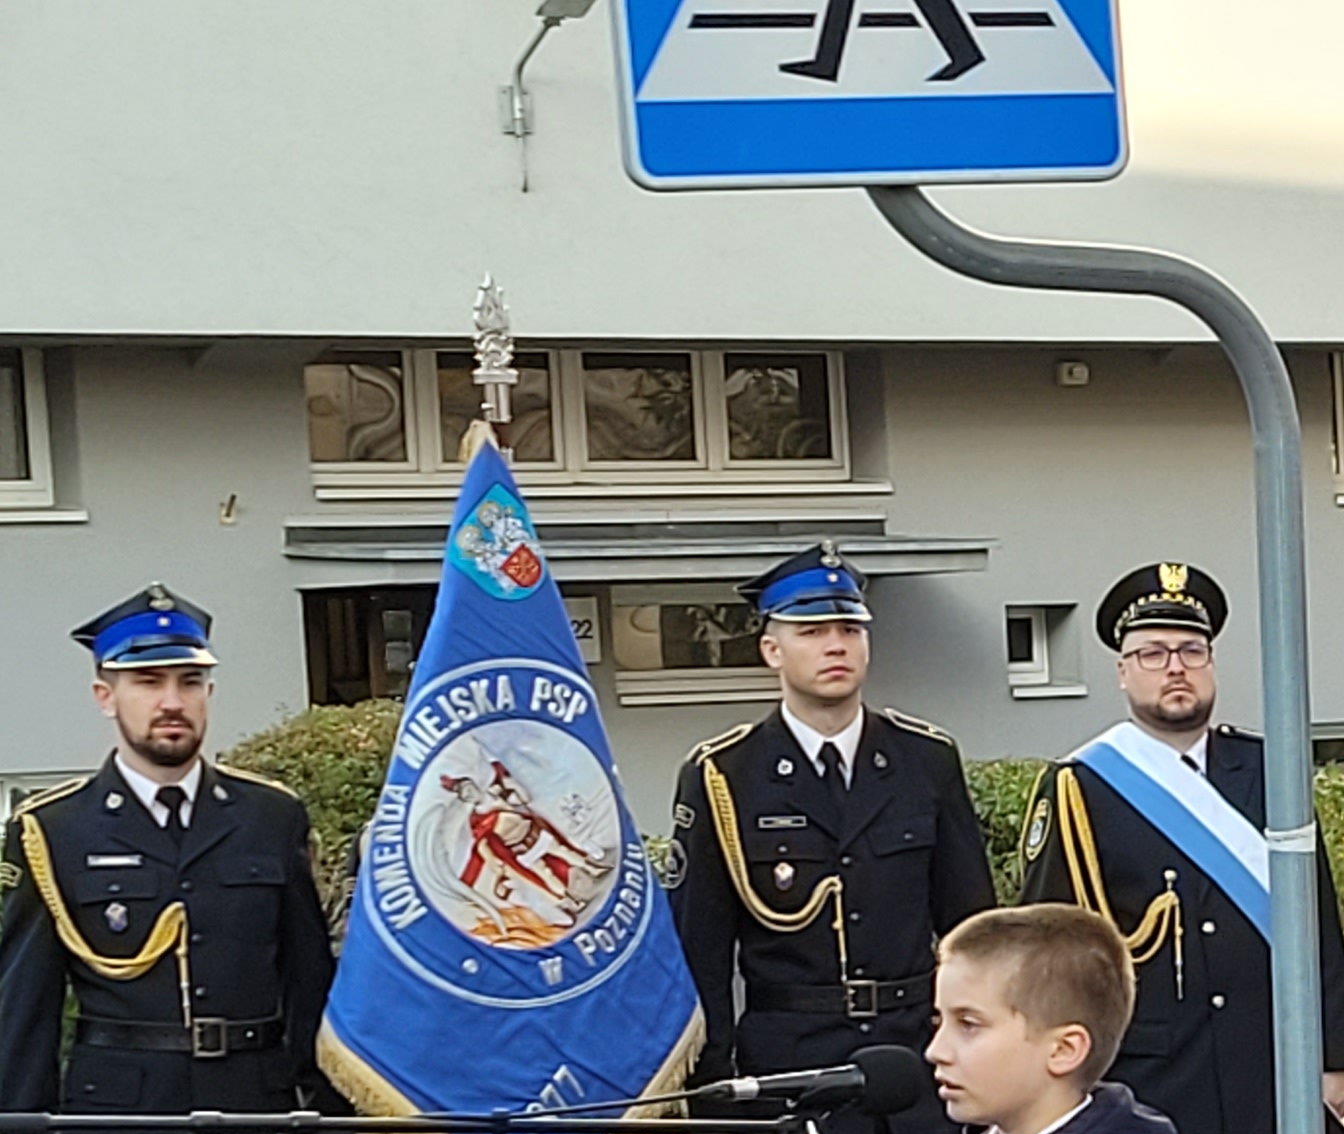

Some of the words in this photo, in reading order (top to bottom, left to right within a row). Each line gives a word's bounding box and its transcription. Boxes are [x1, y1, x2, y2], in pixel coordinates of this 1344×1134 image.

[396, 675, 516, 770] MIEJSKA
[530, 676, 588, 723] PSP
[373, 784, 428, 930] KOMENDA
[574, 843, 645, 966] Poznaniu
